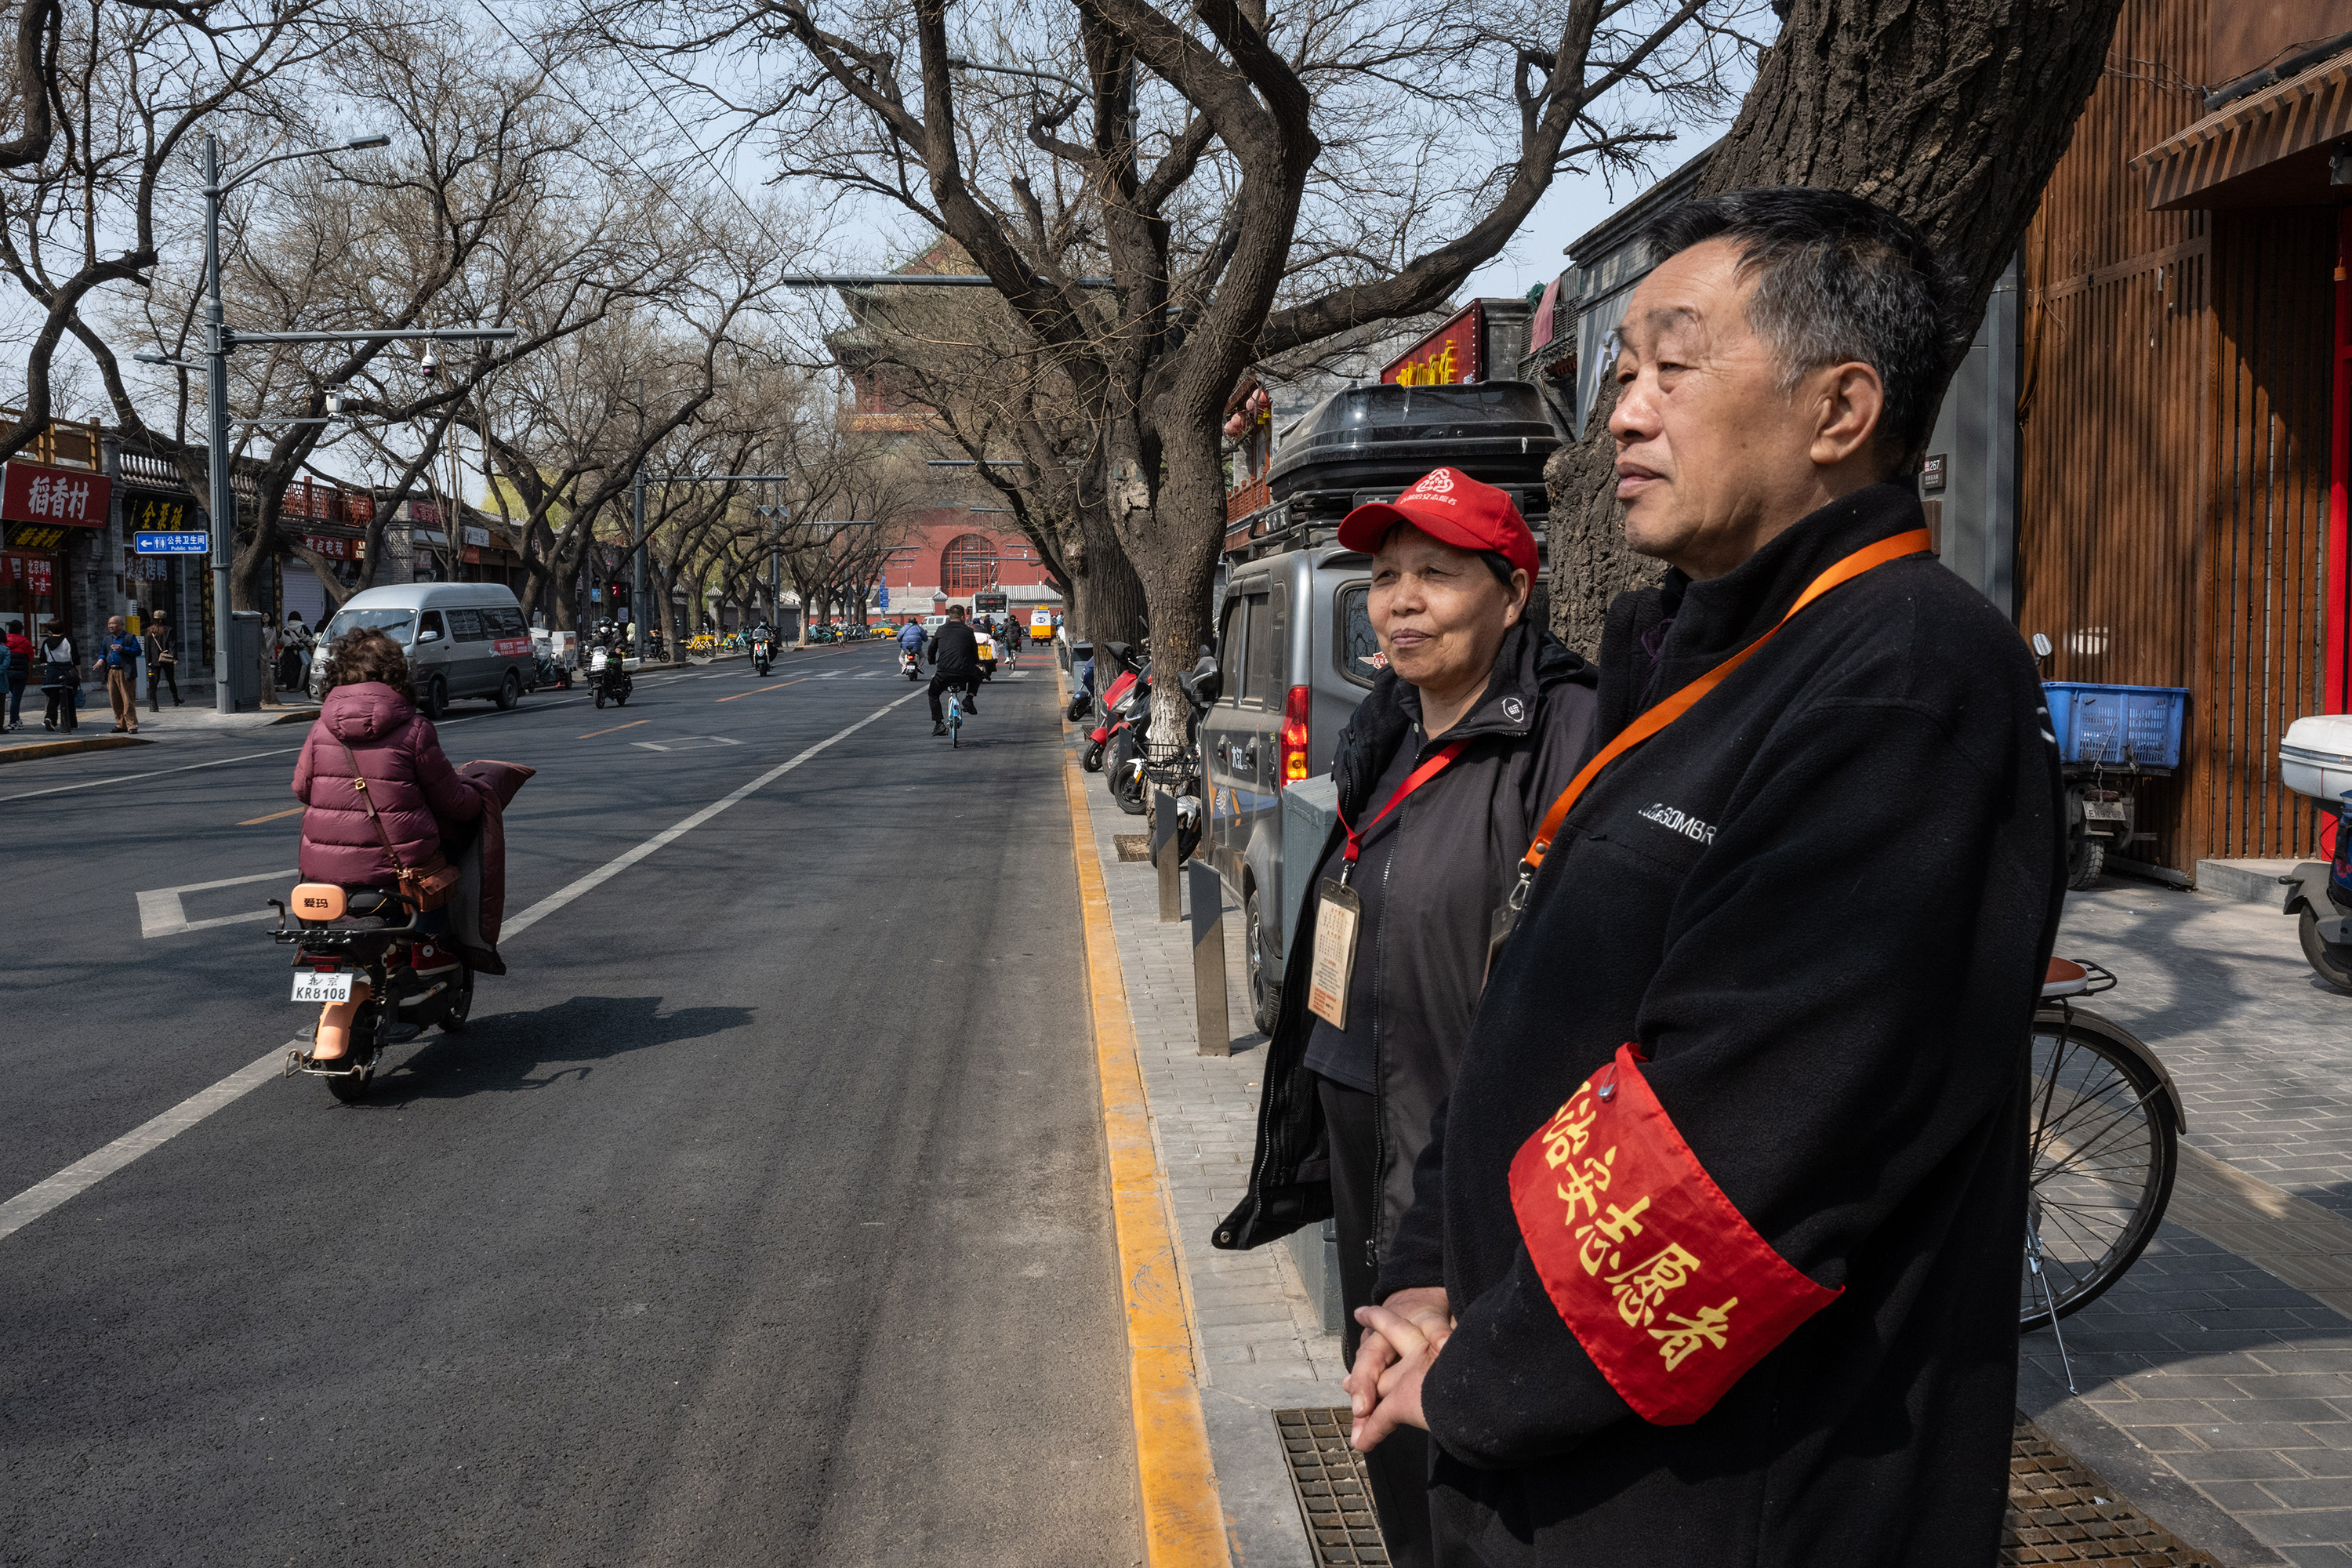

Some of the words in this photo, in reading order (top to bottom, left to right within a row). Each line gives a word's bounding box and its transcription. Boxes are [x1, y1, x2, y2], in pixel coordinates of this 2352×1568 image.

[1929, 459, 1940, 471] 267
[28, 475, 89, 520] 稻香村
[142, 500, 183, 531] 全聚德
[15, 527, 64, 548] 稻香村
[167, 535, 205, 546] 公共卫生间
[28, 559, 51, 575] 北京烤鸭
[303, 898, 328, 908] 爱玛
[308, 975, 339, 986] 北京
[296, 986, 346, 1000] KR8108
[1542, 1080, 1739, 1373] 治安志愿者
